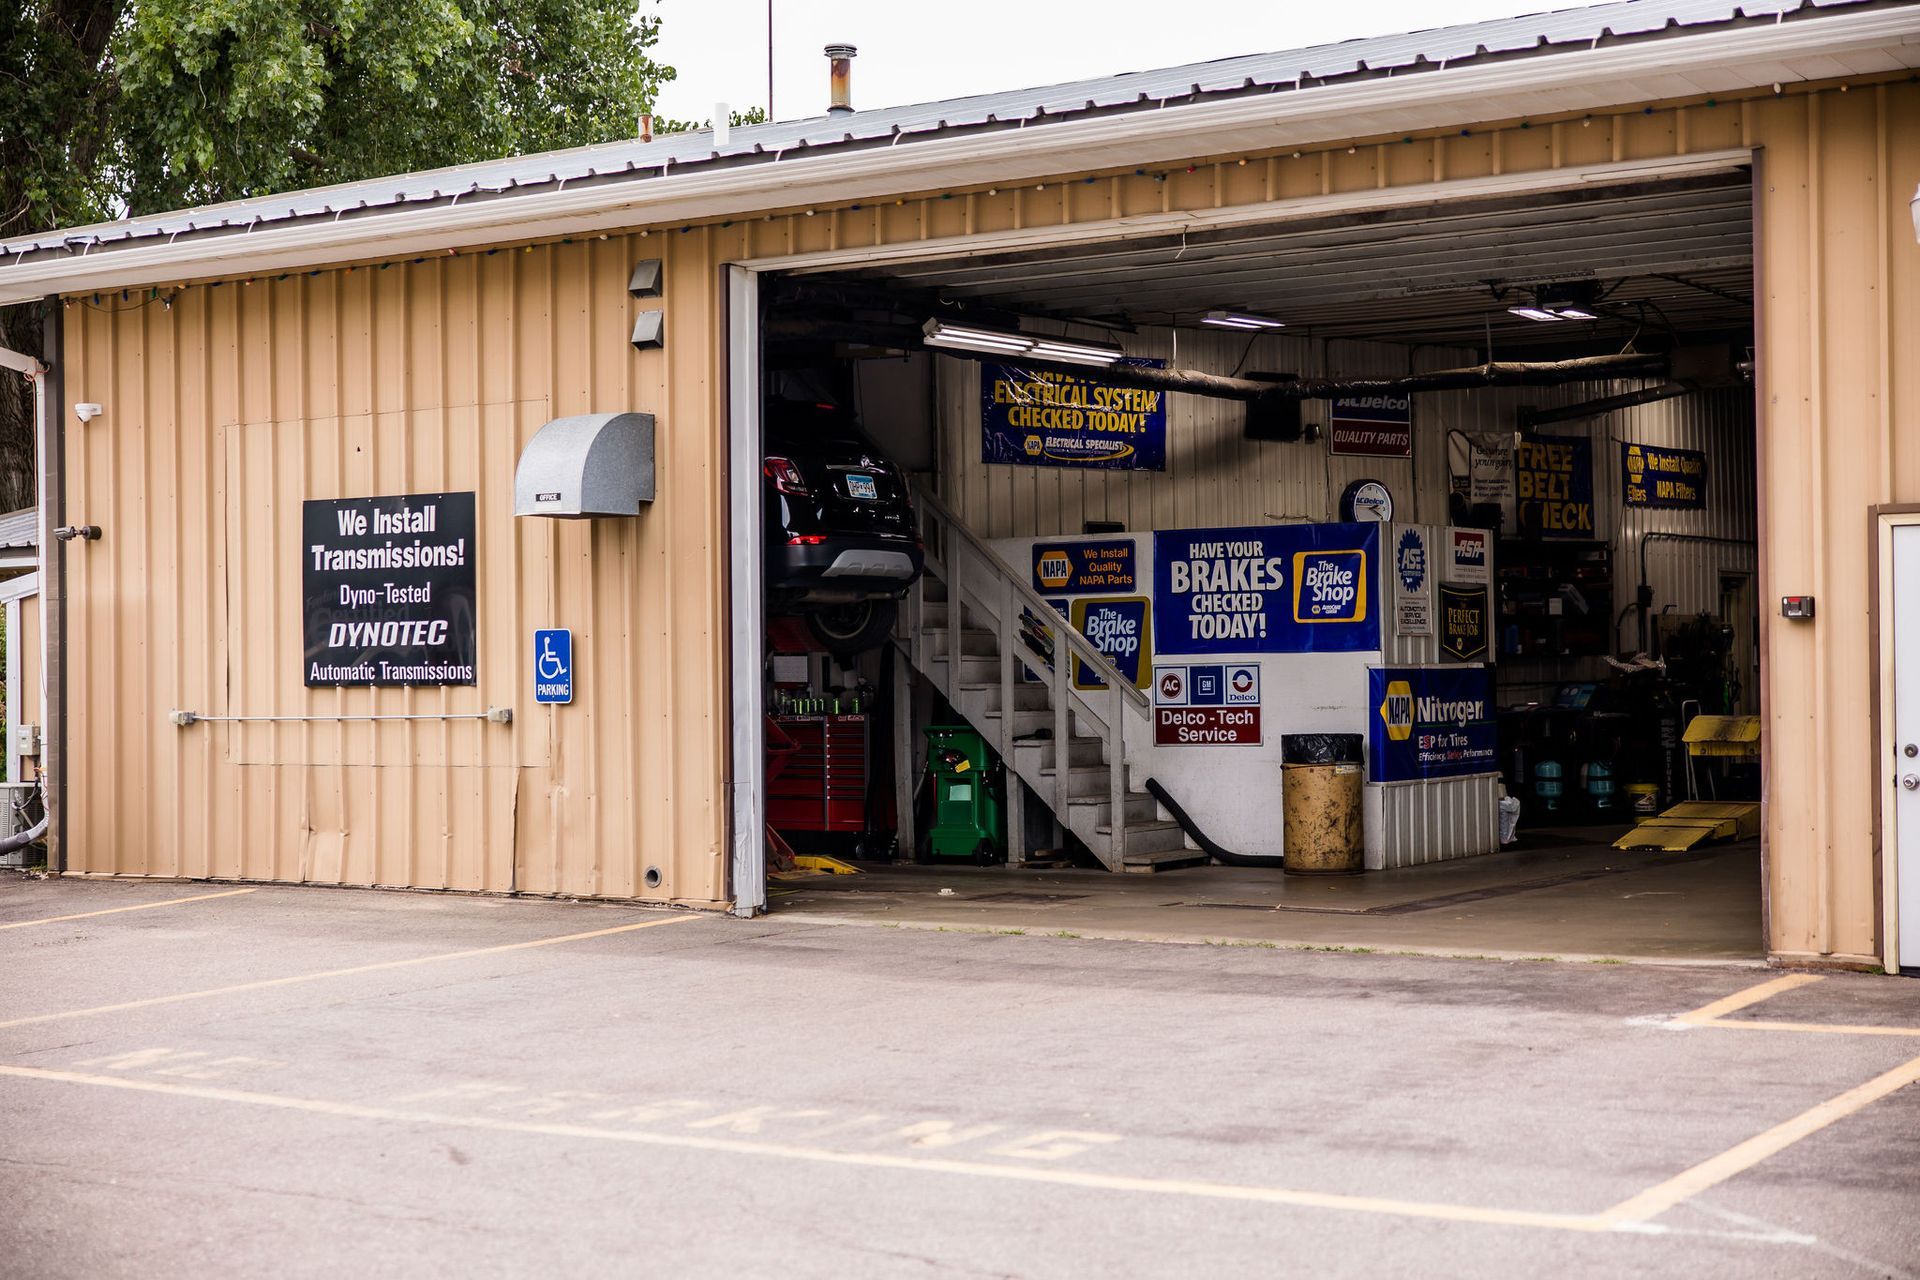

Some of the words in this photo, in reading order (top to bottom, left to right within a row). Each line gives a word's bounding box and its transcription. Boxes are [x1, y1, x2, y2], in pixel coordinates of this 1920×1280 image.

[994, 379, 1090, 408] ELECTRICAL
[1094, 388, 1157, 412] SYSTEM
[1008, 407, 1084, 430] CHECKED
[1087, 410, 1146, 433] TODAY!
[1026, 440, 1041, 450] NAPA
[1046, 436, 1083, 449] ELECTRICAL
[1085, 439, 1123, 451] SPECIALIST
[1334, 430, 1376, 444] QUALITY
[1377, 432, 1409, 445] PARTS
[1519, 441, 1573, 471] FREE
[1647, 453, 1658, 471] We
[1659, 454, 1680, 472] Install
[1519, 471, 1570, 500] BELT
[1628, 485, 1647, 502] Filters
[1657, 481, 1674, 498] NAPA
[1676, 483, 1696, 500] Filters
[539, 493, 558, 501] OFFICE
[337, 509, 367, 536] We
[374, 505, 436, 534] Install
[312, 538, 465, 571] Transmissions!
[1084, 549, 1097, 559] We
[1101, 548, 1128, 558] Install
[1190, 542, 1225, 558] HAVE
[1225, 541, 1264, 557] YOUR
[1457, 540, 1482, 557] ASA
[1089, 562, 1122, 573] Quality
[1318, 560, 1334, 571] The
[1402, 548, 1421, 569] ASE
[1043, 560, 1067, 578] NAPA
[1171, 557, 1284, 593] BRAKES
[1306, 566, 1352, 586] Brake
[1080, 576, 1104, 585] NAPA
[1107, 575, 1133, 584] Parts
[340, 581, 431, 609] Dyno-Tested
[1192, 593, 1263, 613] CHECKED
[1312, 583, 1354, 606] Shop
[1099, 608, 1116, 619] The
[1448, 607, 1479, 624] PERFECT
[329, 620, 448, 647] DYNOTEC
[1087, 614, 1136, 636] Brake
[1189, 613, 1266, 639] TODAY!
[1467, 623, 1479, 637] JOB
[1095, 633, 1138, 657] Shop
[310, 661, 375, 681] Automatic
[379, 660, 472, 681] Transmissions
[537, 683, 569, 696] PARKING
[1163, 681, 1179, 691] AC
[1202, 680, 1212, 690] GM
[1162, 711, 1206, 725] Delco
[1388, 696, 1410, 726] NAPA
[1417, 696, 1484, 727] Nitrogen
[1178, 728, 1237, 741] Service
[1418, 735, 1436, 749] ESP
[1438, 734, 1448, 747] for
[1449, 733, 1468, 746] Tires
